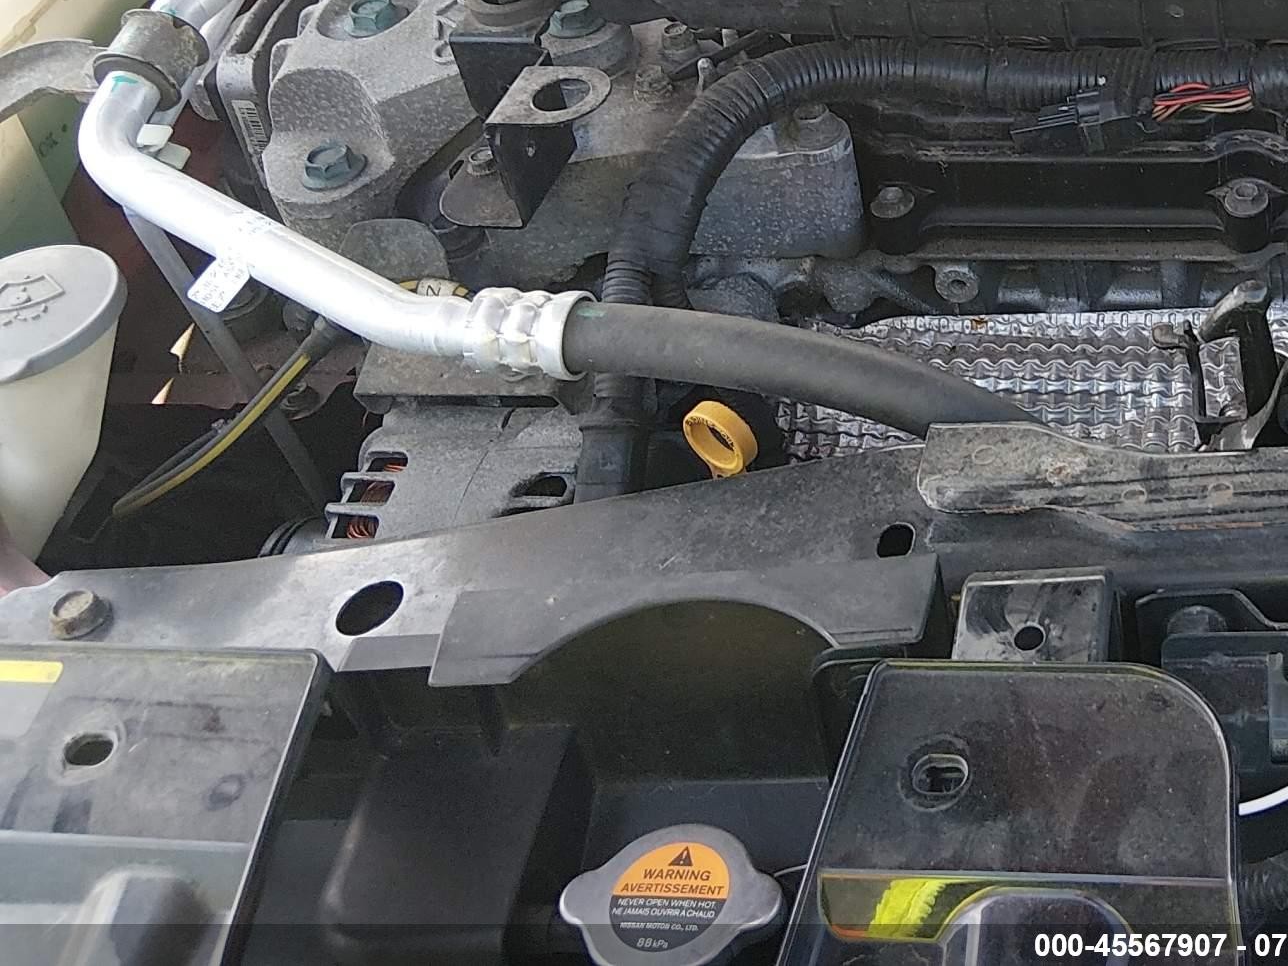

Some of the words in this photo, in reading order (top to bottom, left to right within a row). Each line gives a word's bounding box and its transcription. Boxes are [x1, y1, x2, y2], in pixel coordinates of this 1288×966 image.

[643, 868, 711, 881] WARNING
[620, 882, 725, 895] AVERTISSEMENT
[618, 898, 644, 906] NEVER
[645, 898, 669, 907] OPEN
[670, 899, 696, 908] WHEN
[611, 907, 622, 915] NE
[623, 907, 650, 915] JAMAIS
[650, 908, 679, 916] OUVRIR
[686, 909, 716, 918] CHAUD
[620, 921, 645, 929] NISSAN
[646, 922, 670, 930] MOTOR
